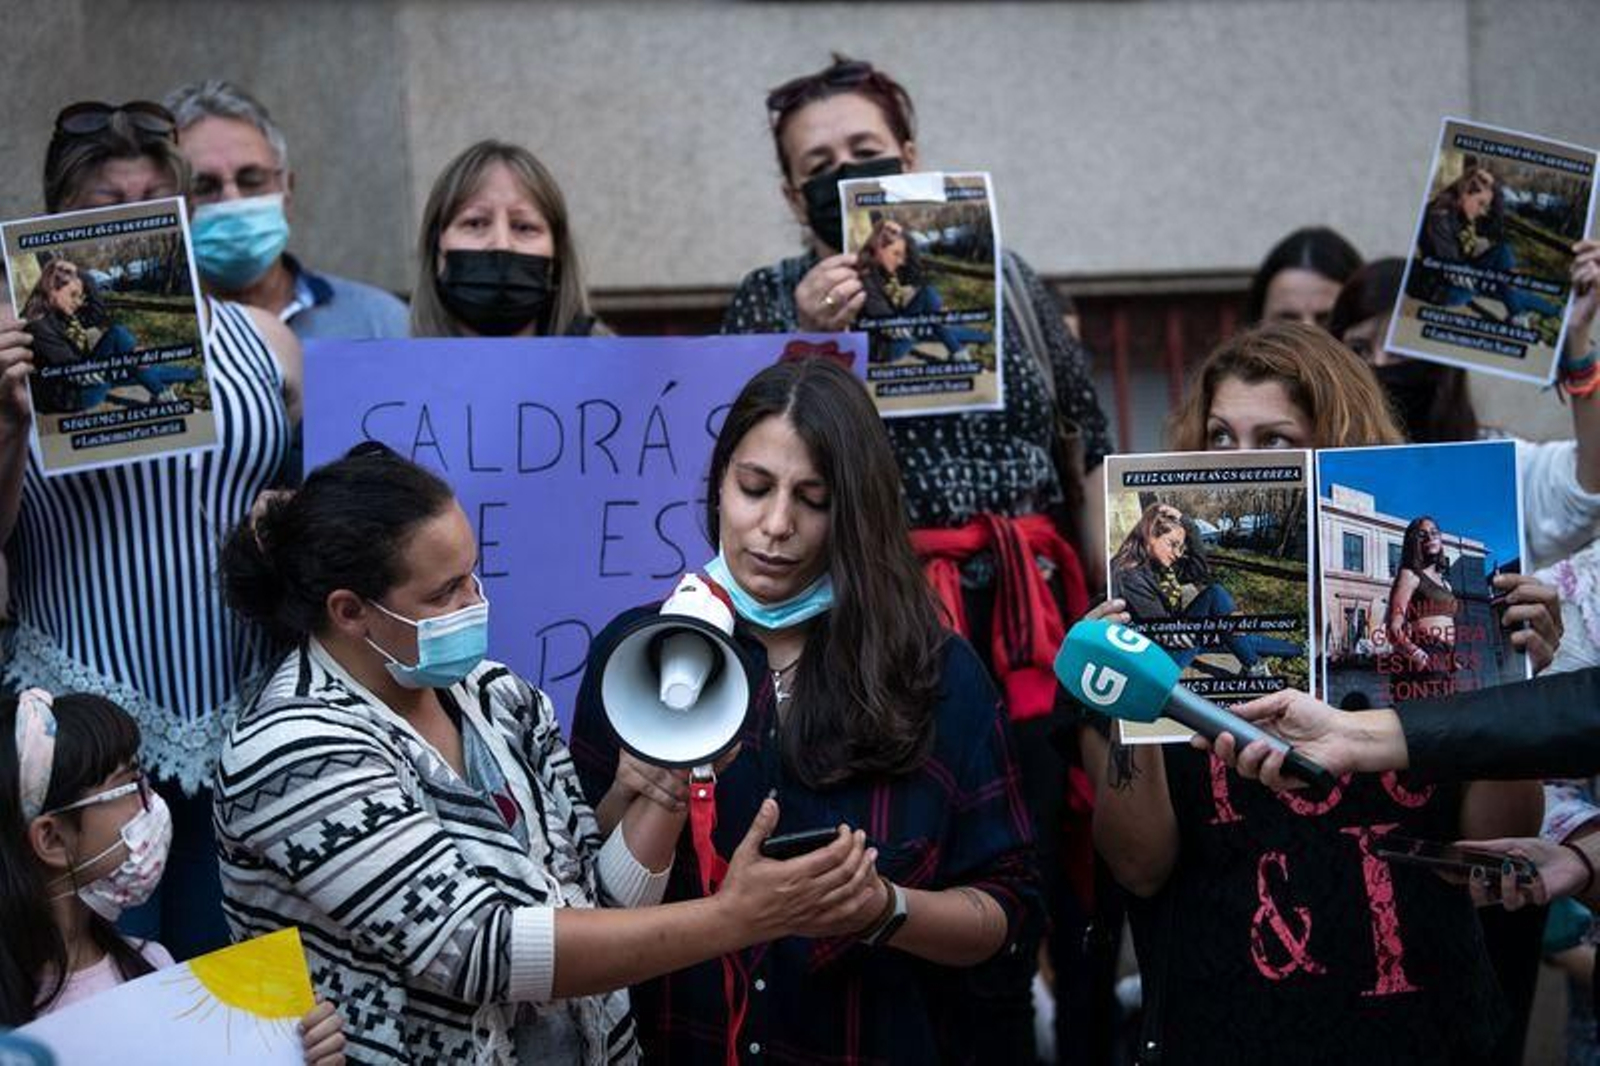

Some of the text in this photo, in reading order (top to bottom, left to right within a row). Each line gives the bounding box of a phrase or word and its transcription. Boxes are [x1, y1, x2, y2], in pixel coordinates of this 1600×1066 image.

[20, 233, 50, 247] FELIZ
[1125, 472, 1158, 485] FELIZ
[1239, 468, 1300, 482] GUERRERA
[1212, 679, 1285, 692] LUCHANDO
